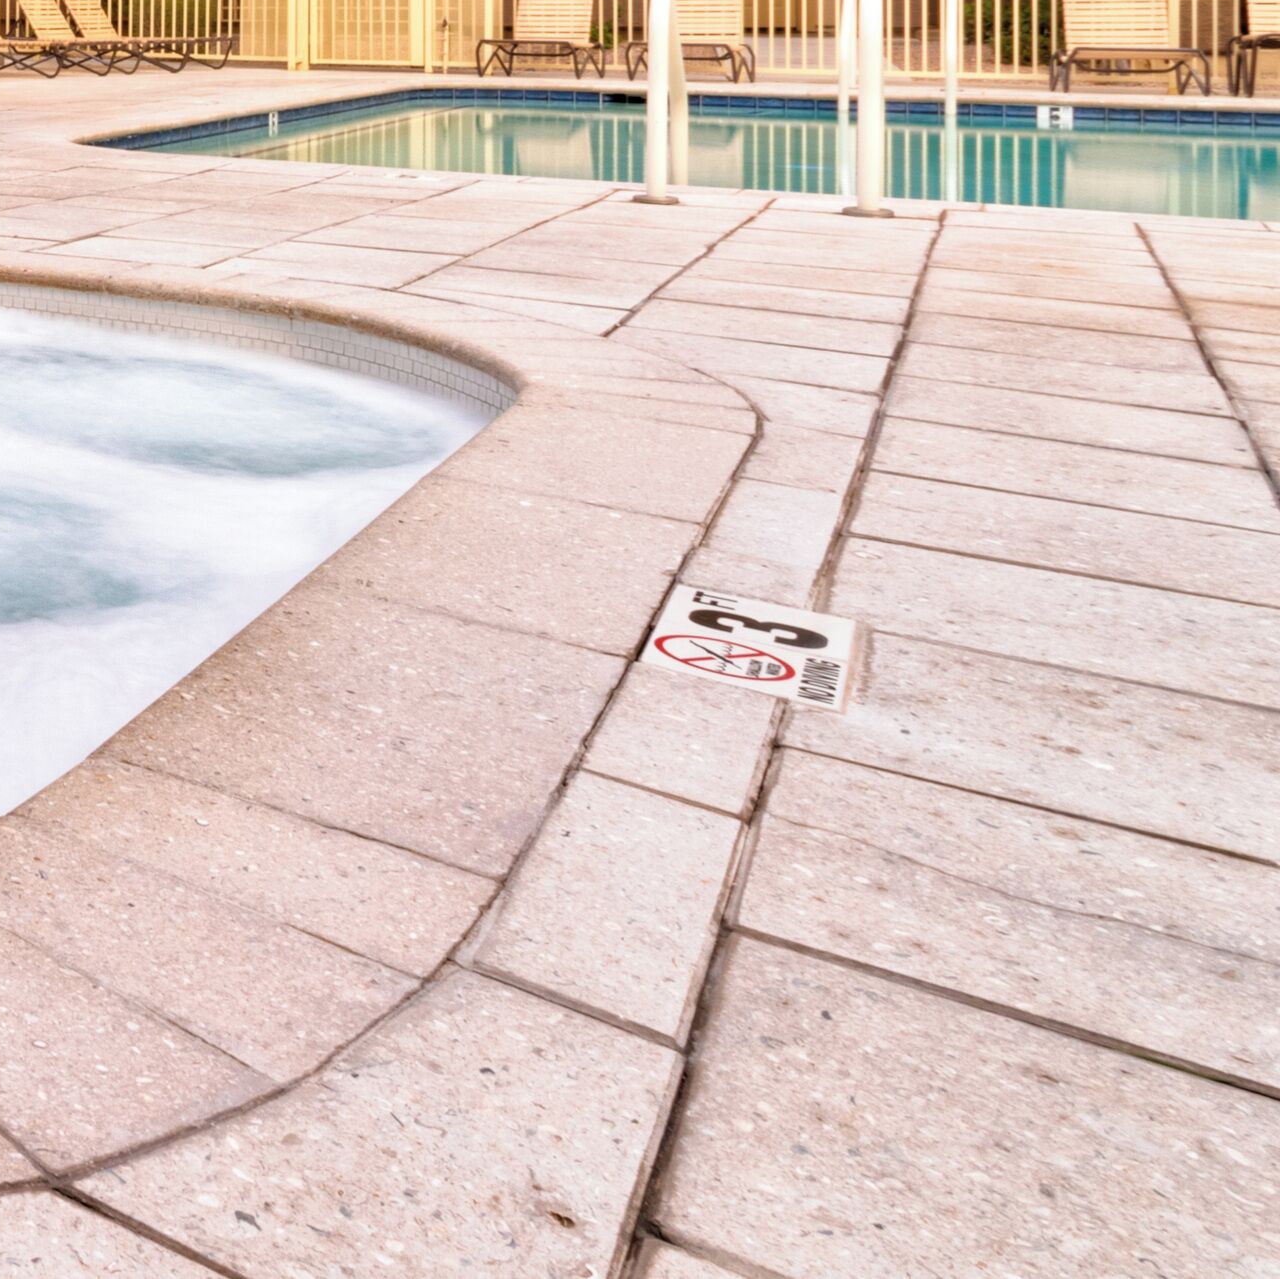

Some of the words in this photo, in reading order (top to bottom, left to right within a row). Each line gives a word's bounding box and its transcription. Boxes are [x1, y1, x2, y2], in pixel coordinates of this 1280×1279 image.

[692, 591, 738, 611] FT
[688, 609, 829, 649] 3
[800, 656, 841, 692] DIVING
[797, 686, 836, 705] NO
